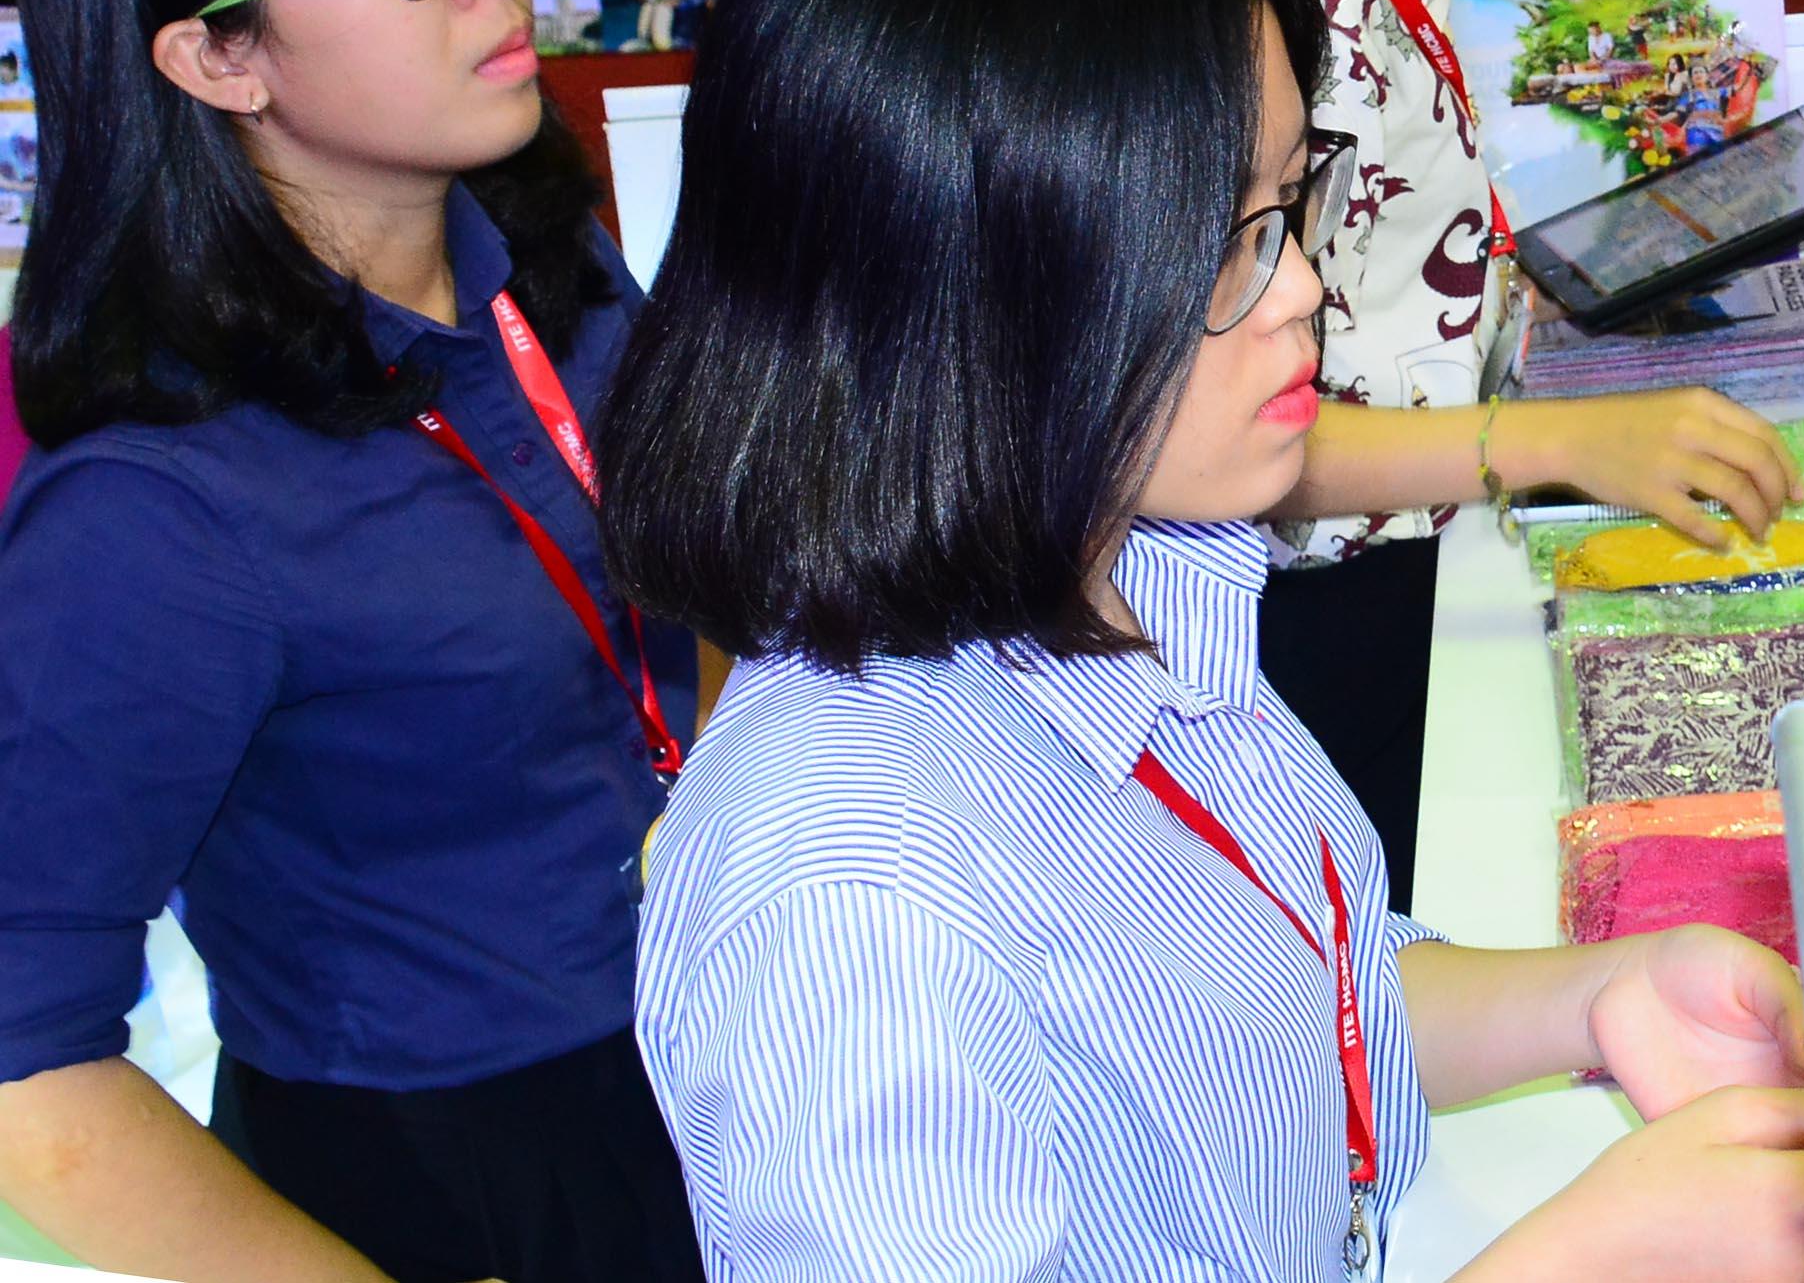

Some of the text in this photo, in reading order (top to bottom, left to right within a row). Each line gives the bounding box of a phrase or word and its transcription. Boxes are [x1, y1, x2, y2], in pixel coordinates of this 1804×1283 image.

[1417, 22, 1454, 74] ITE HCMC
[508, 324, 532, 353] ITE
[1339, 940, 1358, 1049] ITE HCMC
